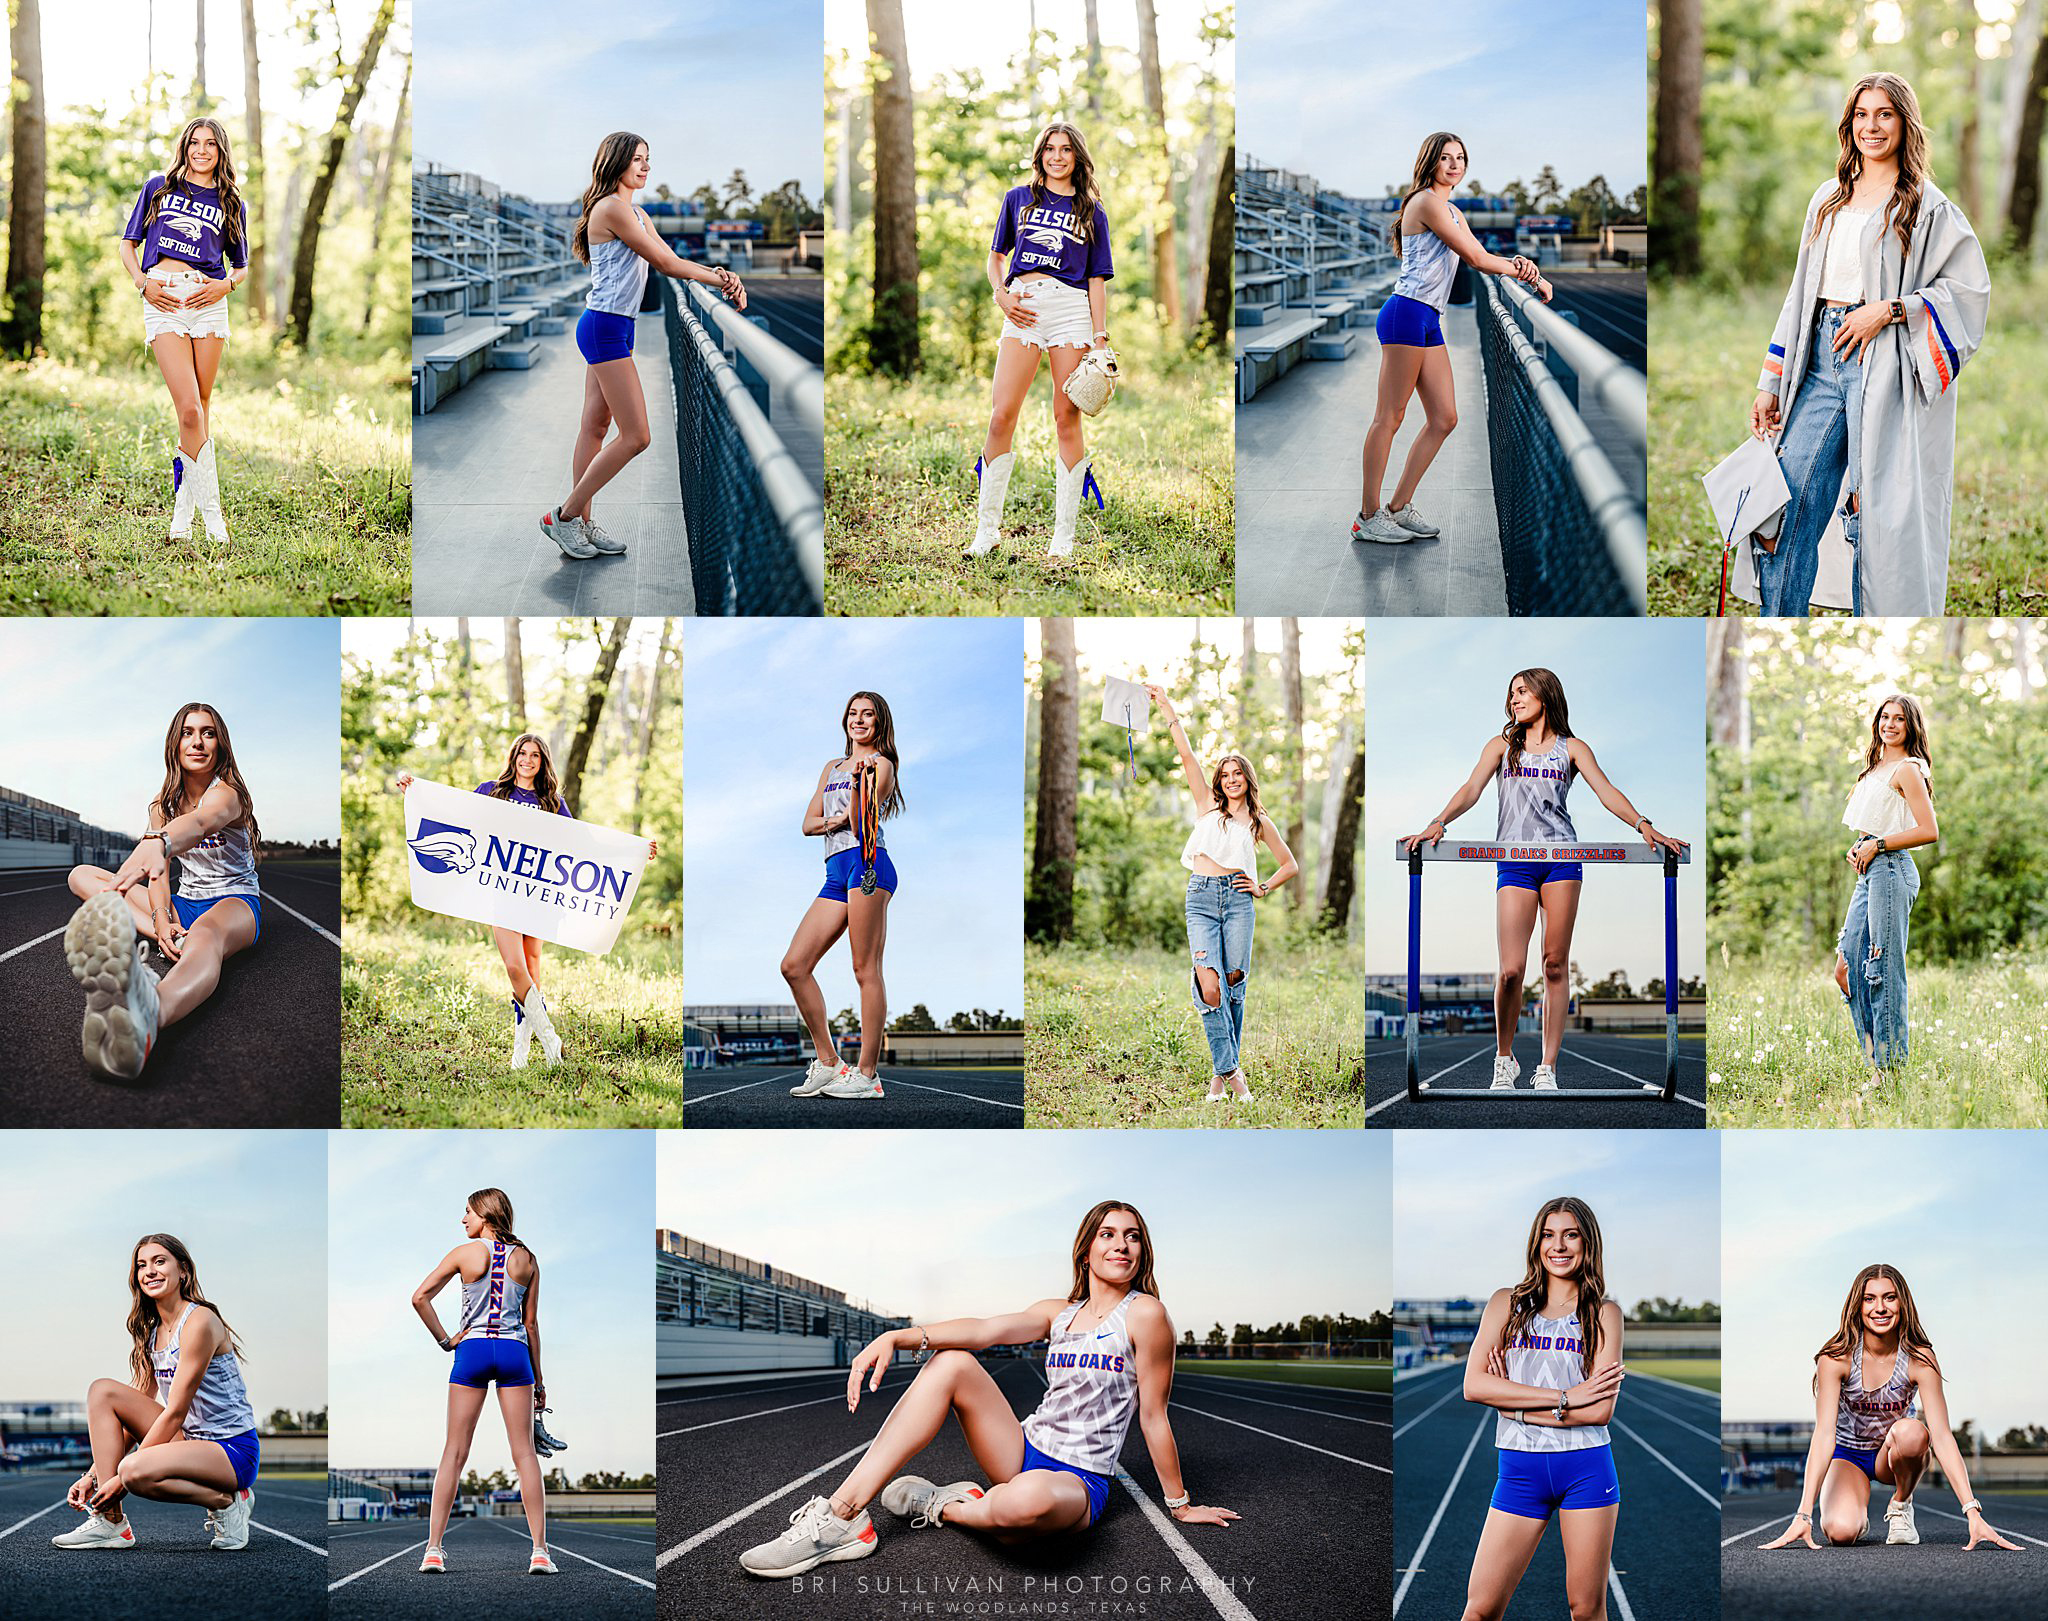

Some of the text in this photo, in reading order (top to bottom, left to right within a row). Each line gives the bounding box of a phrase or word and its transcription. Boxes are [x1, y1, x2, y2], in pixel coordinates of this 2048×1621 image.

[159, 193, 225, 231] NELSON
[158, 236, 201, 258] SOFTBALL
[1020, 251, 1062, 270] SOFTBALL
[1458, 847, 1627, 861] GRAND OAKS GRIZZLIES
[481, 834, 633, 903] NELSON
[478, 870, 620, 920] UNIVERSITY
[1078, 1353, 1125, 1373] OAKS
